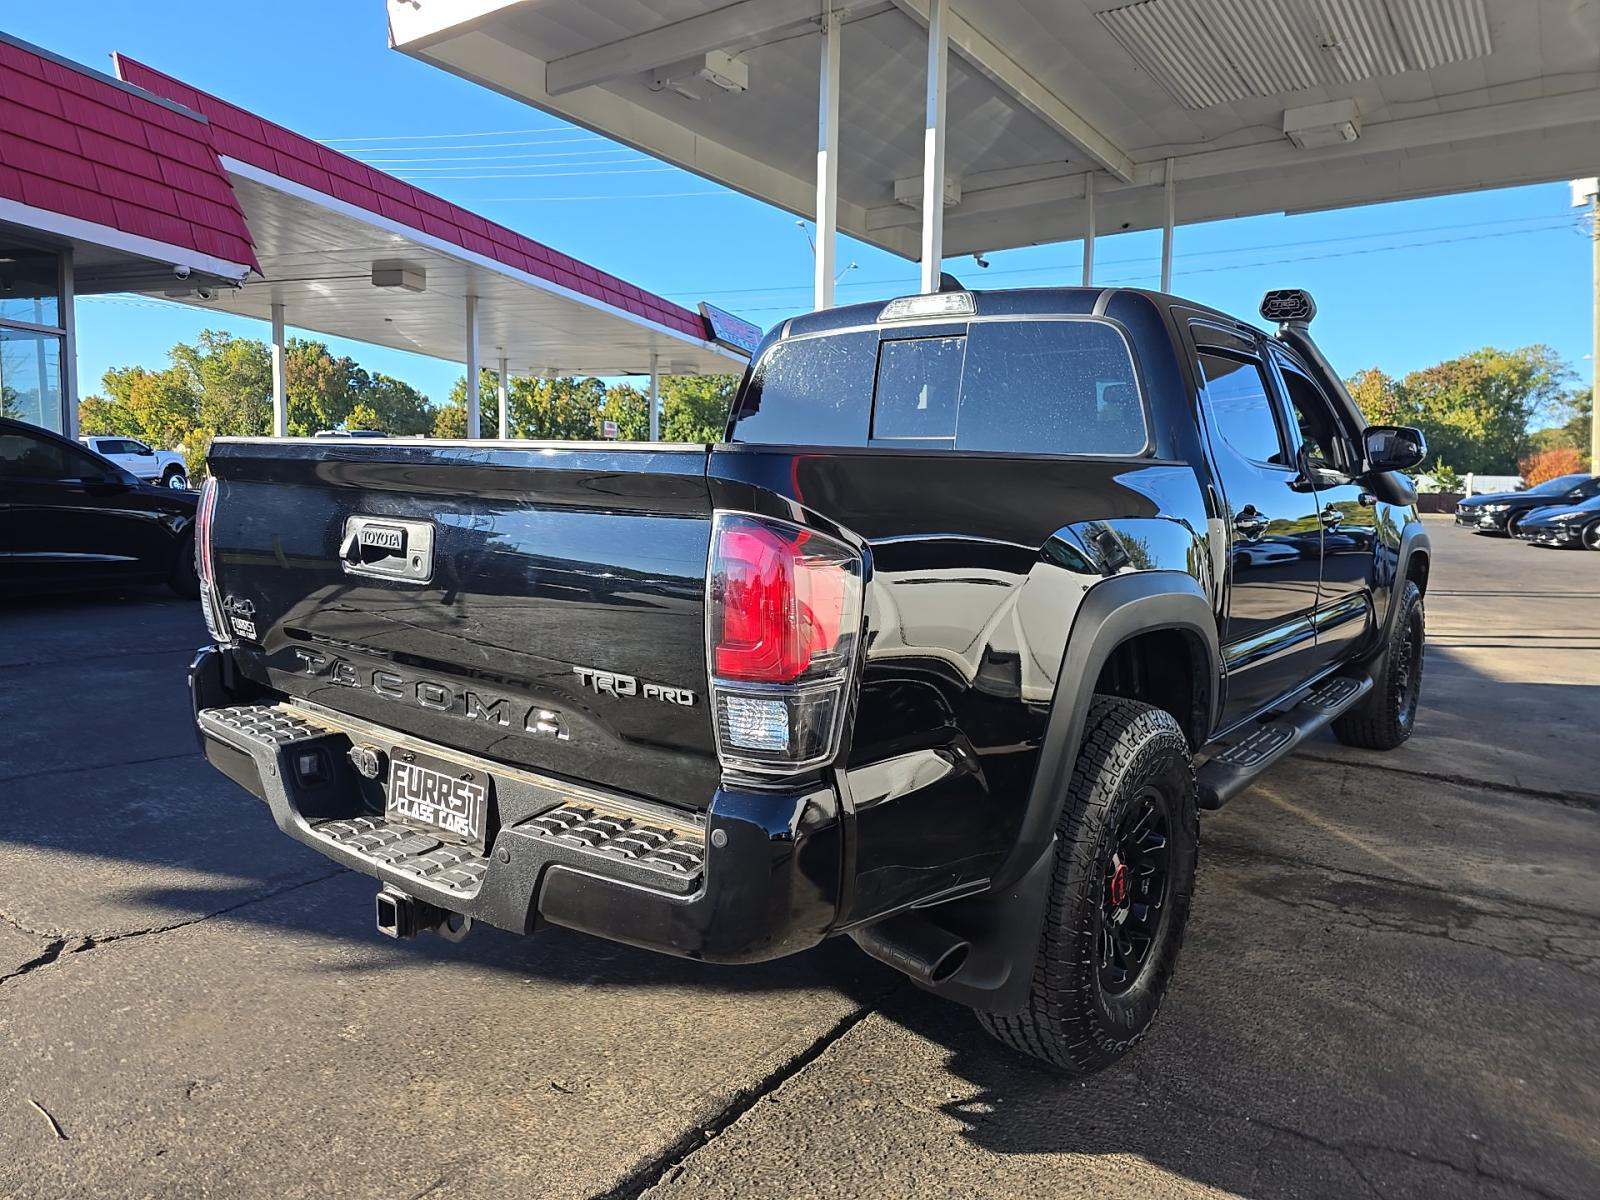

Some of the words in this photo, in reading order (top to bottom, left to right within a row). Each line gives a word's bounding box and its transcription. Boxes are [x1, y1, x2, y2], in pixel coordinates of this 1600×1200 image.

[362, 530, 400, 547] TOYOTA
[295, 649, 570, 741] TACOMA
[573, 666, 637, 699] TRD
[643, 683, 694, 706] PRO
[388, 759, 484, 840] FURRST
[397, 798, 434, 824] CLASS
[439, 809, 469, 836] CARS
